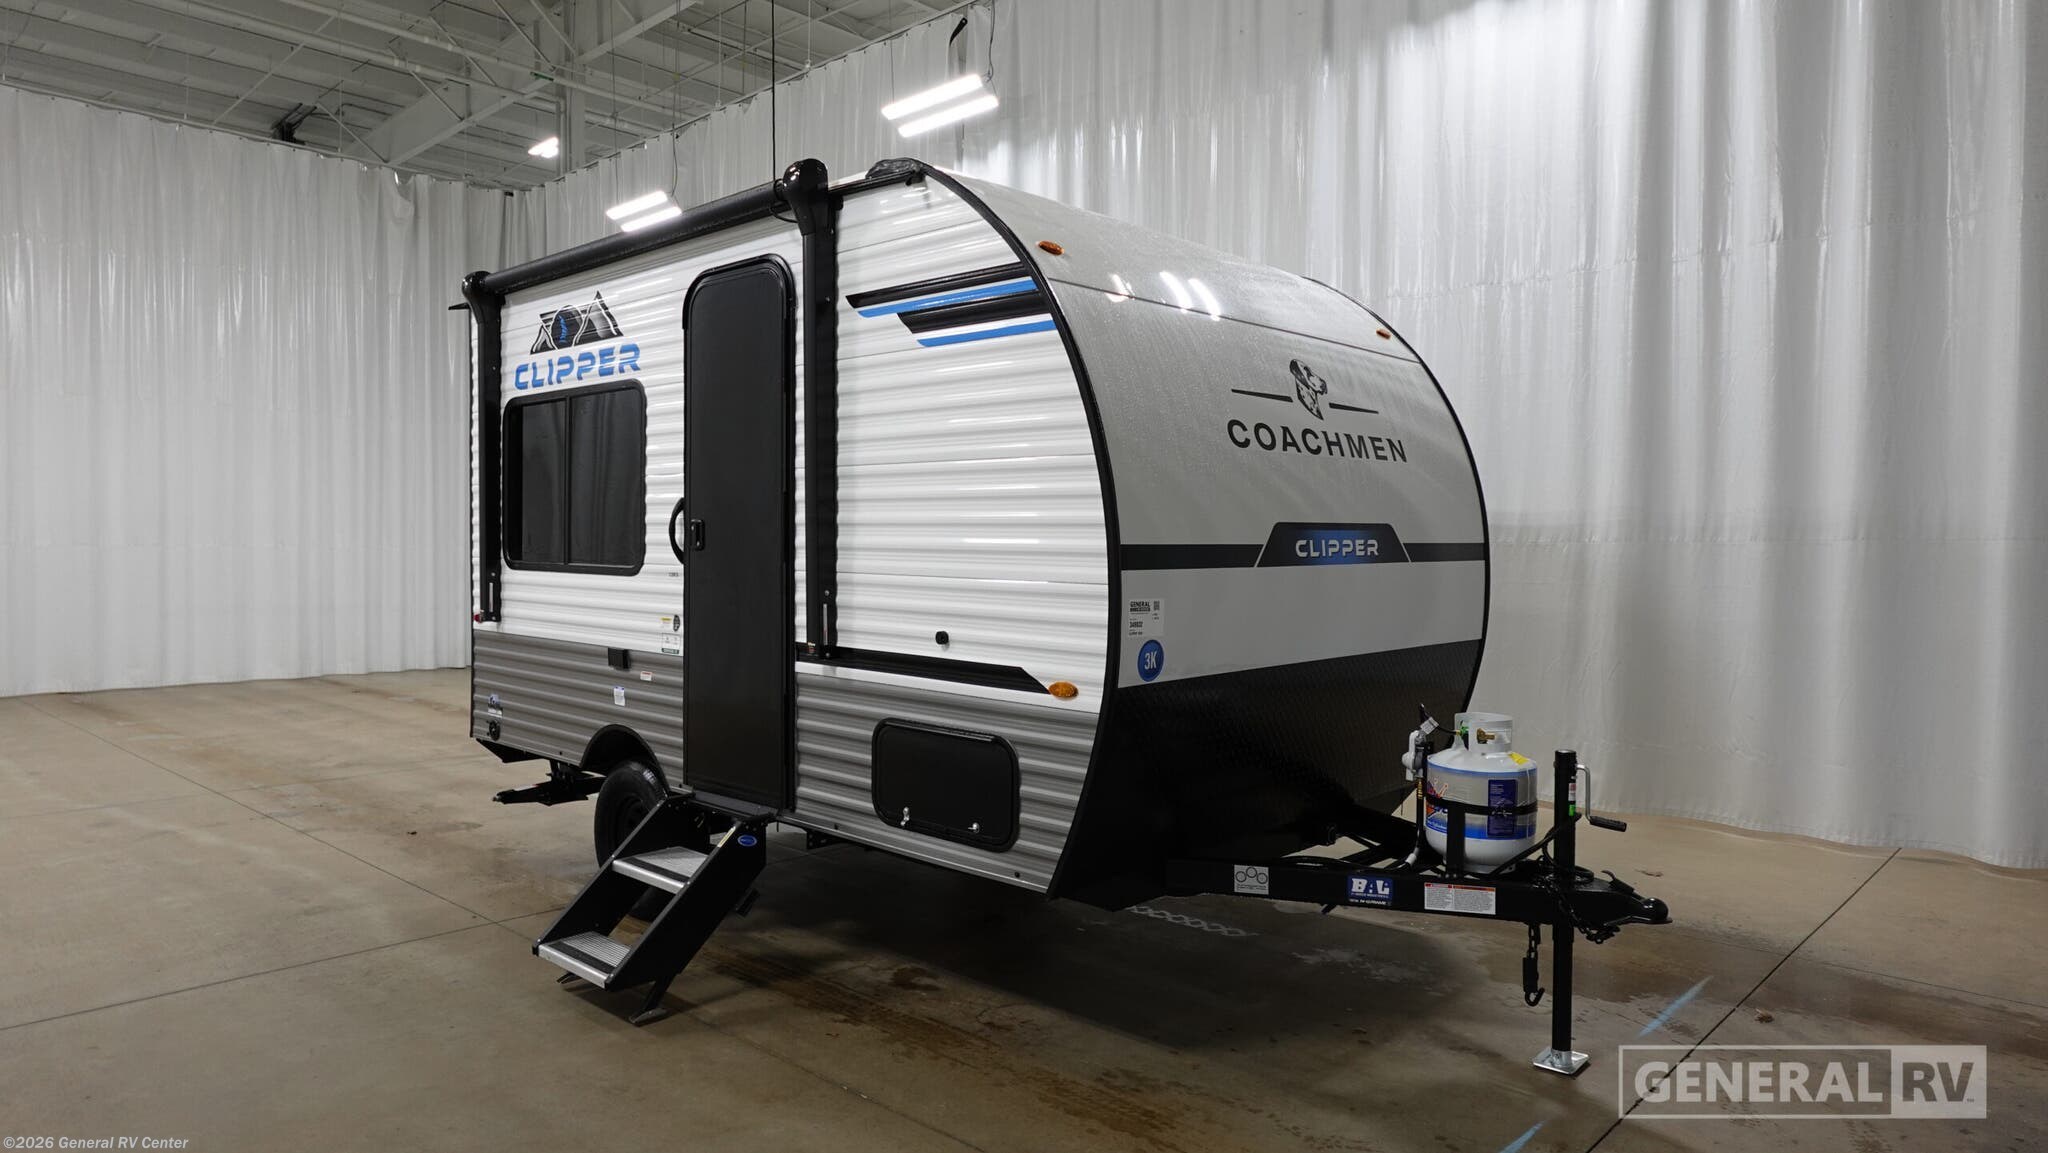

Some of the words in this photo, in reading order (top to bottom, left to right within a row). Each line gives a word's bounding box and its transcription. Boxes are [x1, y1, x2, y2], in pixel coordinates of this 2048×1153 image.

[515, 343, 641, 390] CLIPPER
[1227, 419, 1407, 463] COACHMEN
[1295, 539, 1379, 558] CLIPPER
[1144, 651, 1157, 670] 3K
